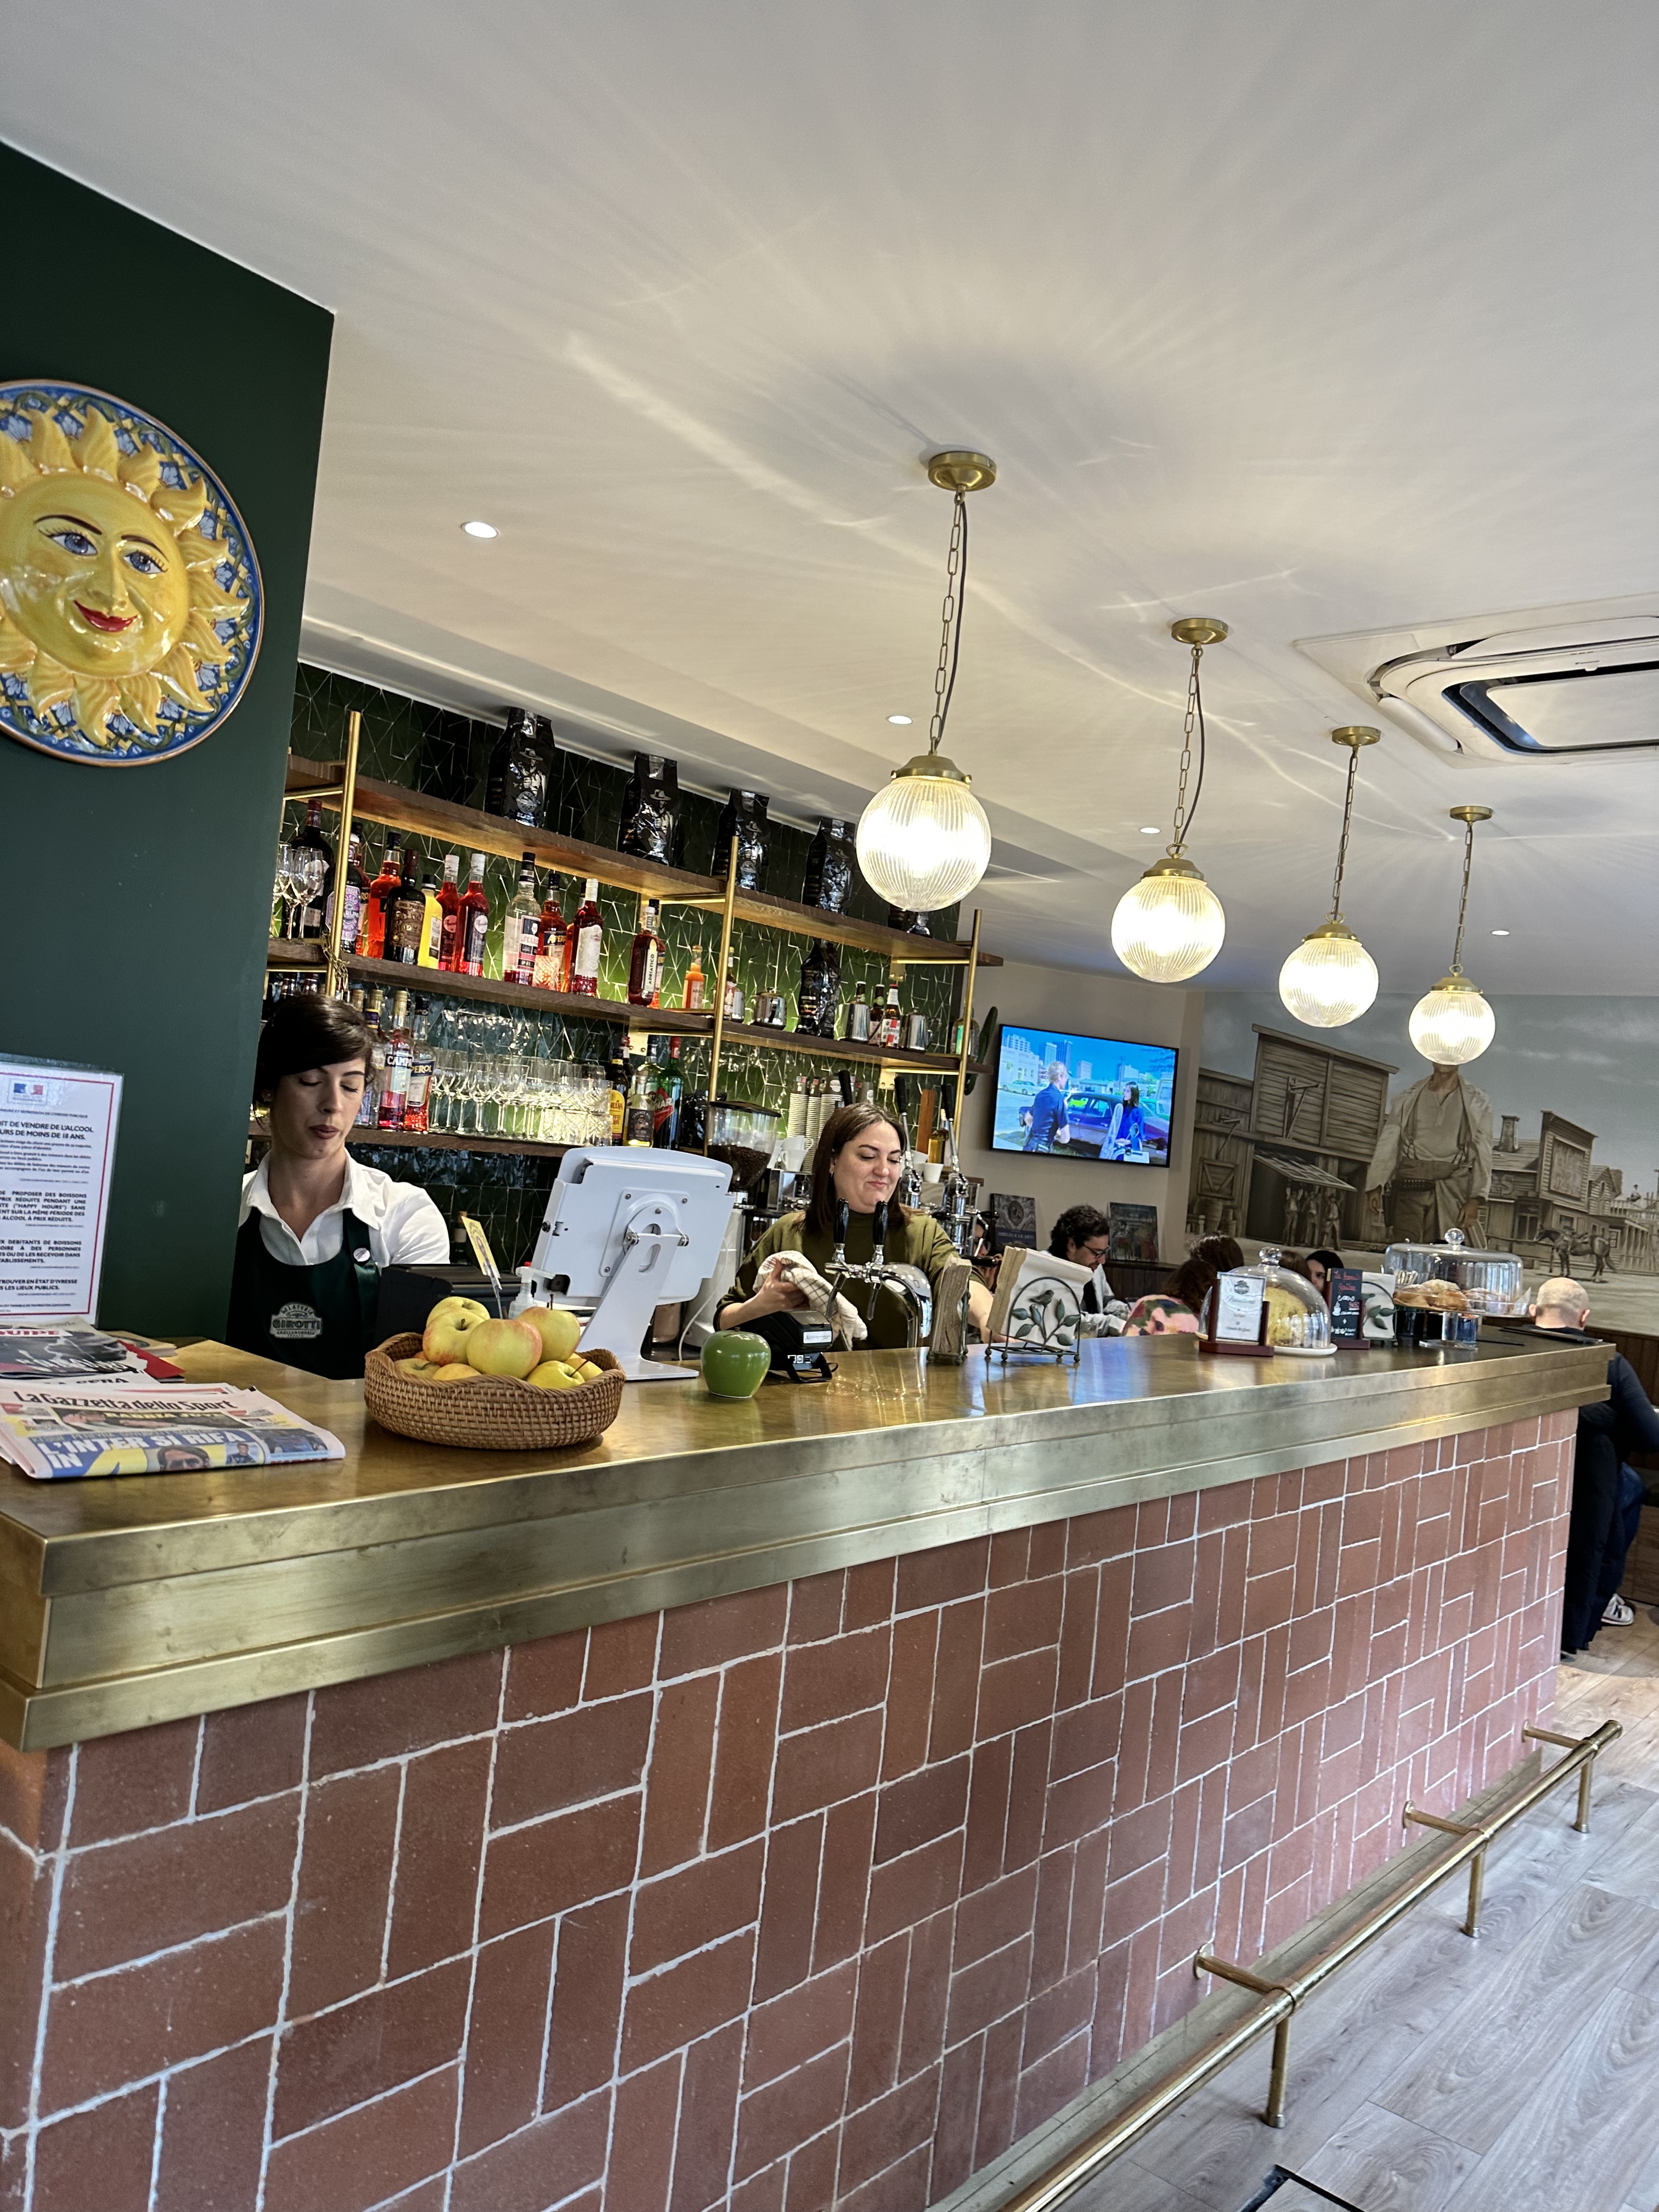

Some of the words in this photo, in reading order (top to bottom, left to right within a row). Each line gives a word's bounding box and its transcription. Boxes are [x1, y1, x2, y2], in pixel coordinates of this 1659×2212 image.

[273, 1319, 320, 1330] GIROTTI
[14, 1391, 42, 1403] La
[40, 1393, 132, 1409] Gazzetta
[132, 1400, 182, 1410] dello
[177, 1400, 238, 1411] Sport
[37, 1436, 150, 1455] L'INTER
[150, 1435, 182, 1447] SI
[182, 1430, 246, 1444] RIFA
[47, 1453, 83, 1469] IN
